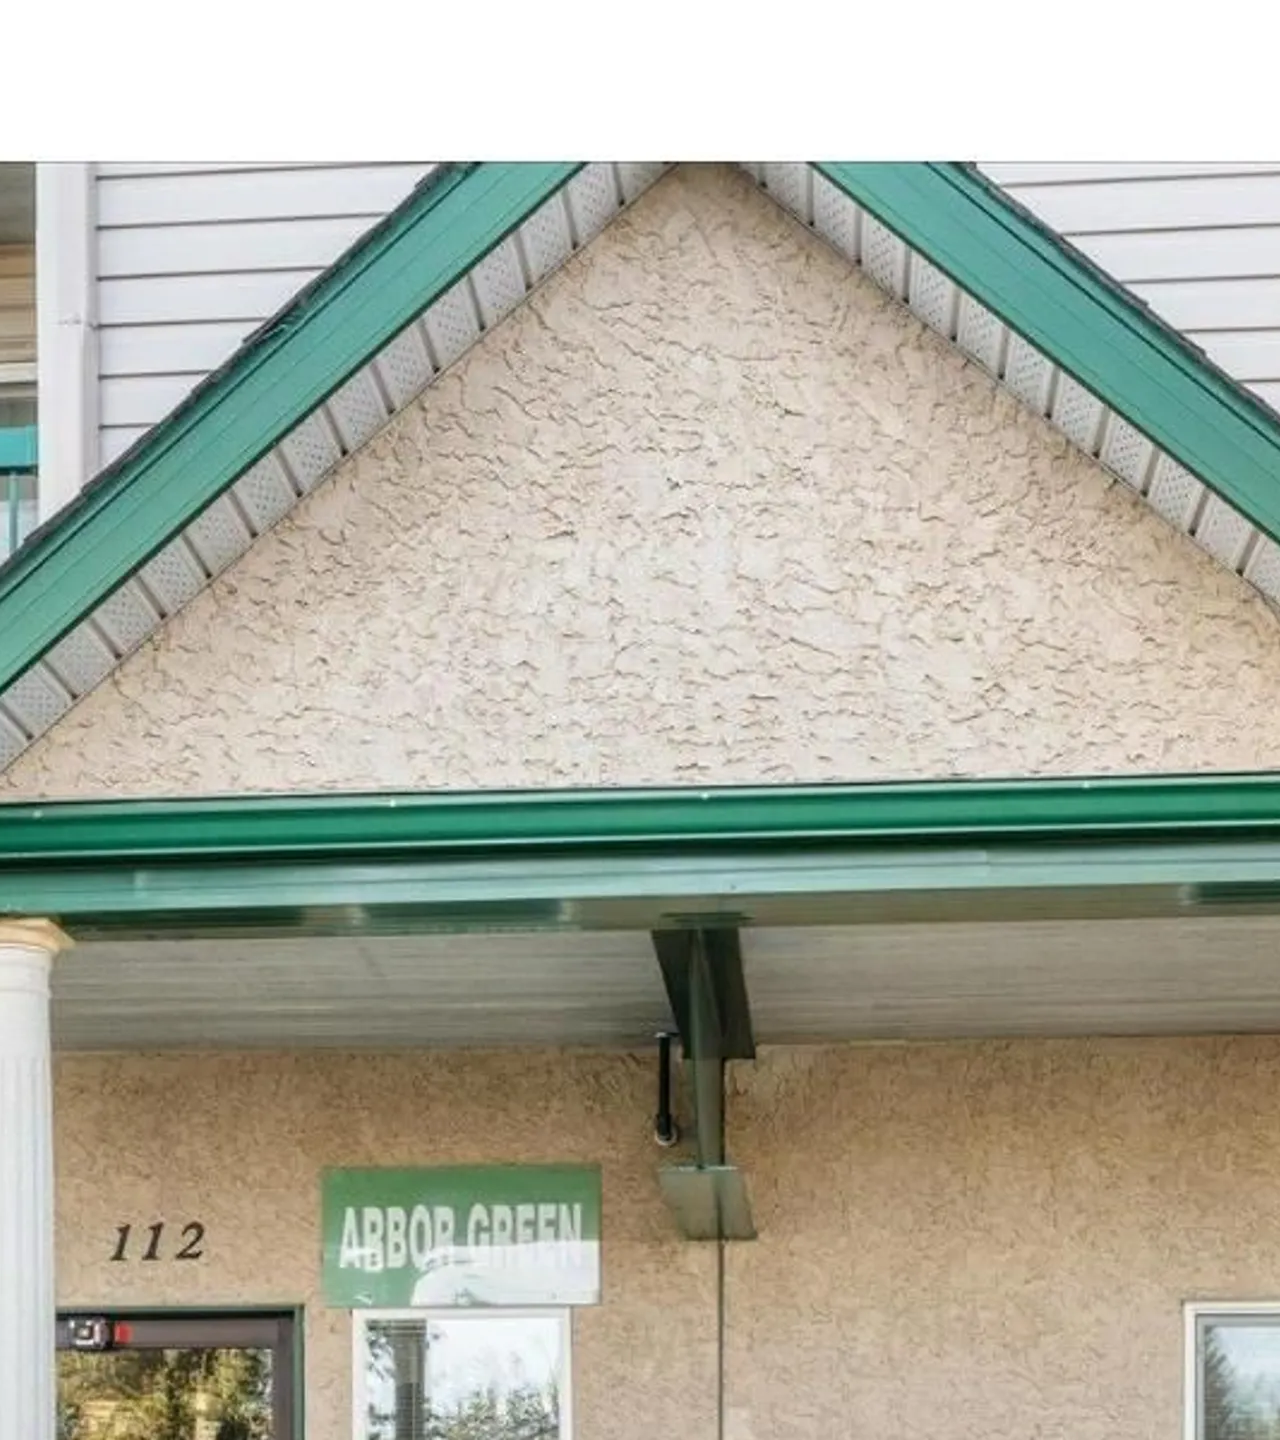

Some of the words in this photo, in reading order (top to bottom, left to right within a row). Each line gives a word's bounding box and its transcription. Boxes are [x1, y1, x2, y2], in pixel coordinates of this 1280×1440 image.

[109, 1221, 205, 1261] 112
[338, 1204, 455, 1272] ARBOR
[467, 1202, 582, 1268] GREEN
